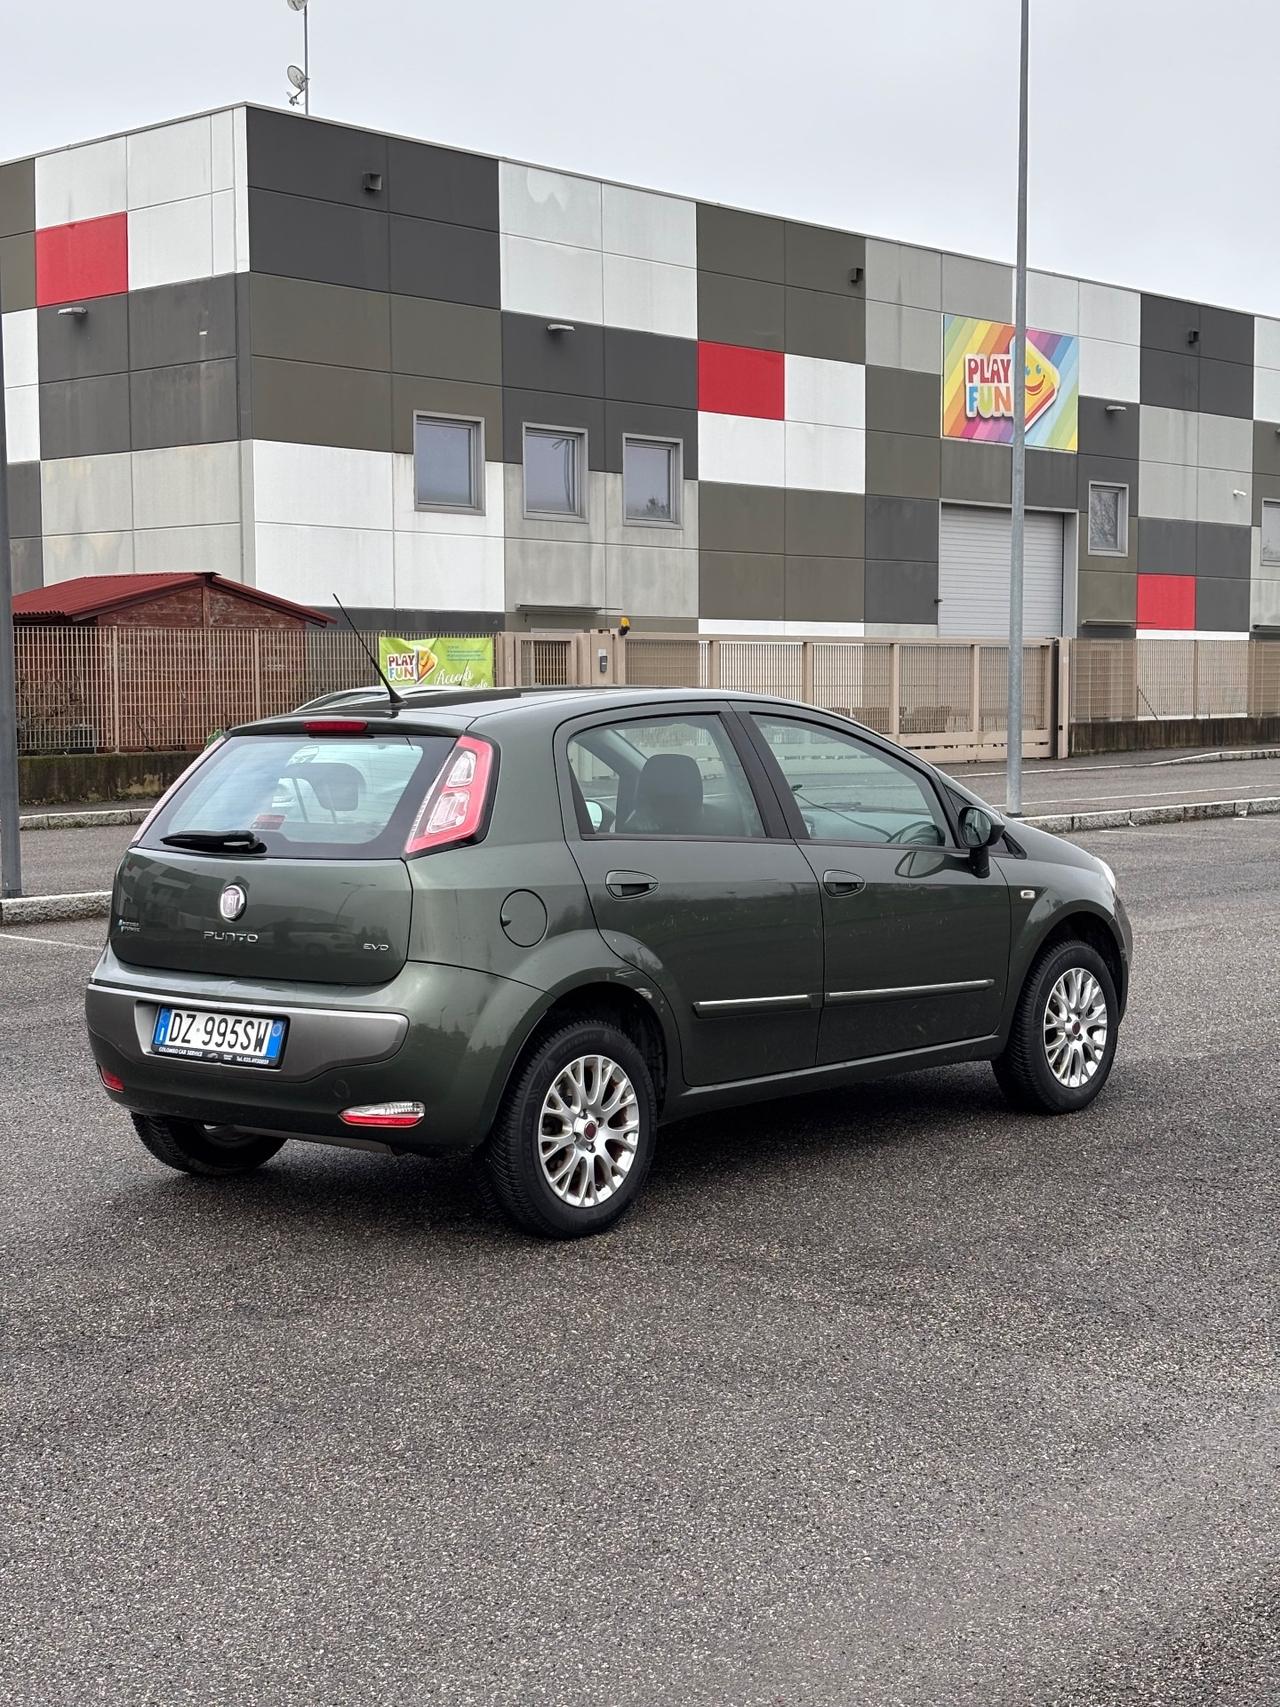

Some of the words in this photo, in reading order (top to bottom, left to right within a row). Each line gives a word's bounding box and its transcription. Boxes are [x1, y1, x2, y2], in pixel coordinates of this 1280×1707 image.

[967, 358, 1012, 384] PLAY
[968, 386, 1012, 413] FUN
[388, 655, 415, 667] PLAY
[388, 667, 415, 679] FUN
[203, 931, 259, 943] PUNTO
[363, 943, 389, 951] EVO
[168, 1012, 197, 1044] DZ
[201, 1016, 270, 1053] 995SW
